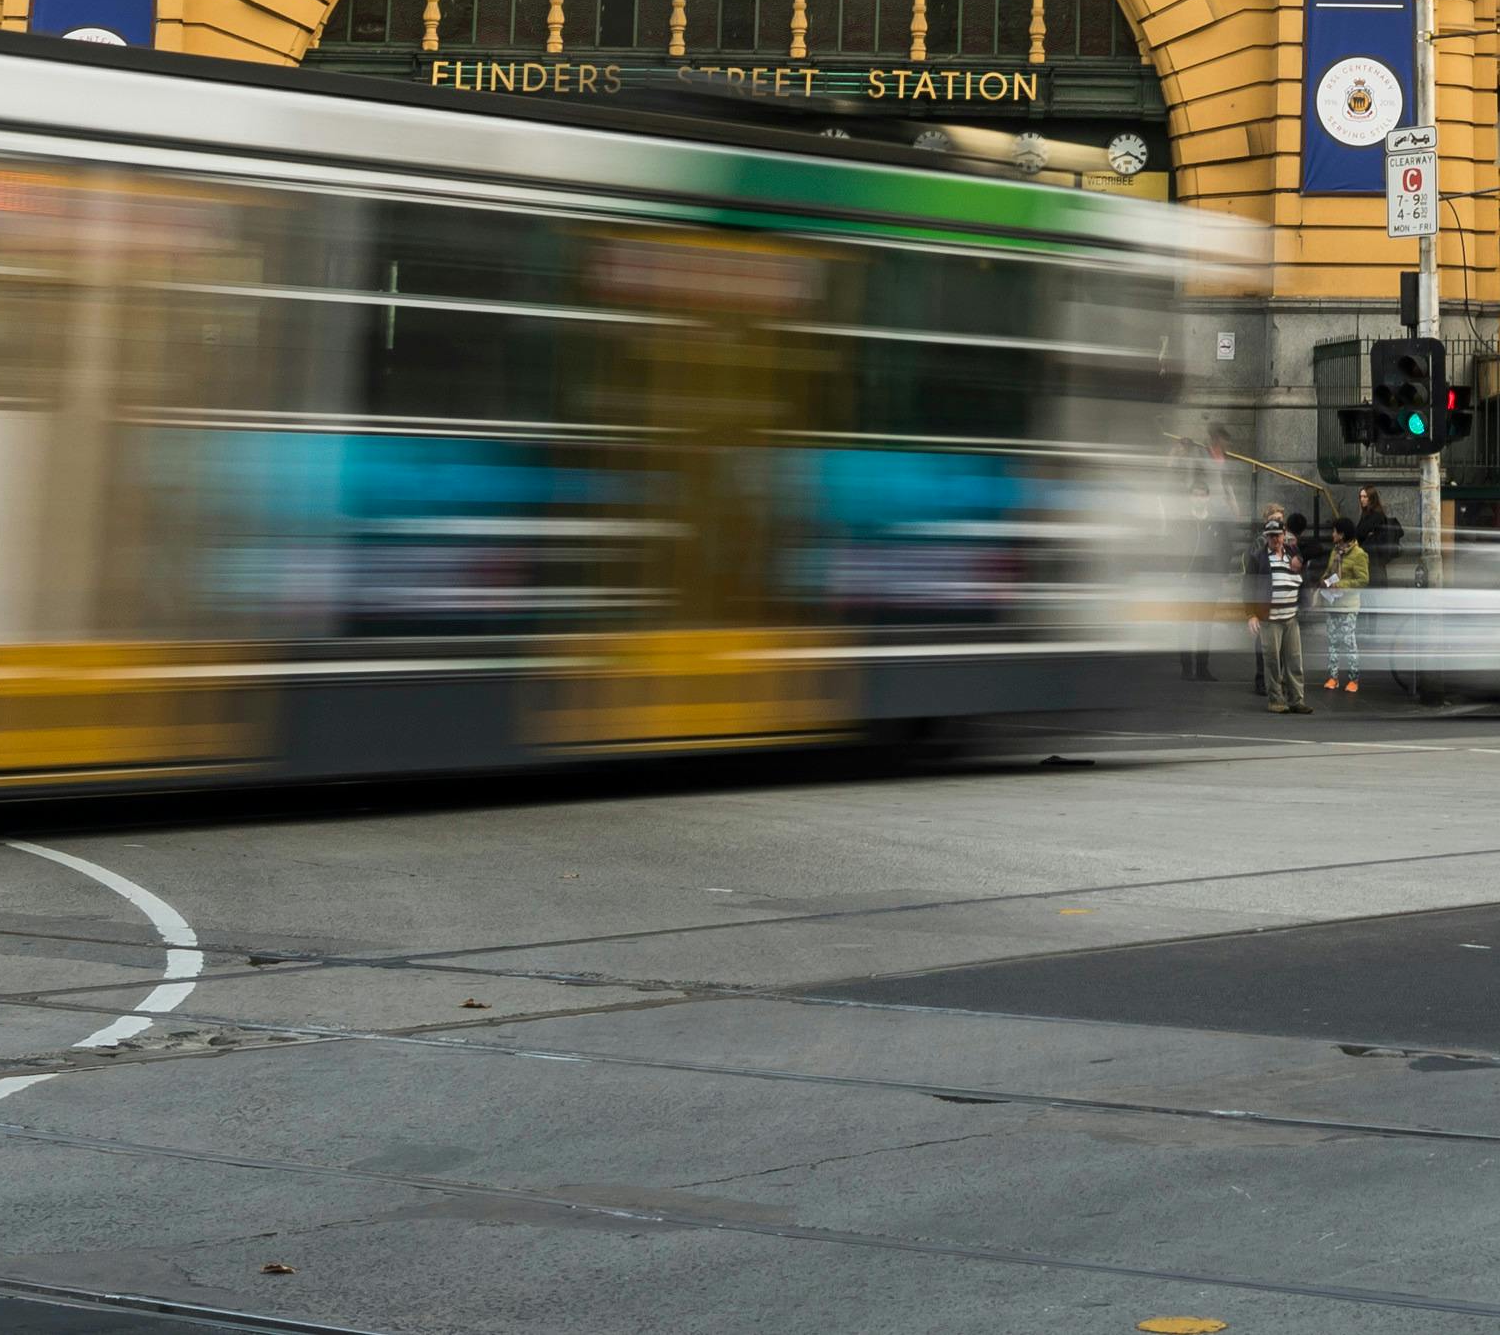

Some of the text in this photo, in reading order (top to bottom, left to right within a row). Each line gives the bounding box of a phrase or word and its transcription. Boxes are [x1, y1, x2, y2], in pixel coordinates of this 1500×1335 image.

[431, 60, 1039, 102] FLINDERS STREET STATION
[1342, 64, 1396, 90] CENTENARY
[1328, 115, 1366, 139] SERVING
[1389, 154, 1434, 168] CLEARWAY
[1087, 175, 1134, 186] WERRIBEE
[1406, 169, 1418, 192] C
[1419, 222, 1432, 231] FRI
